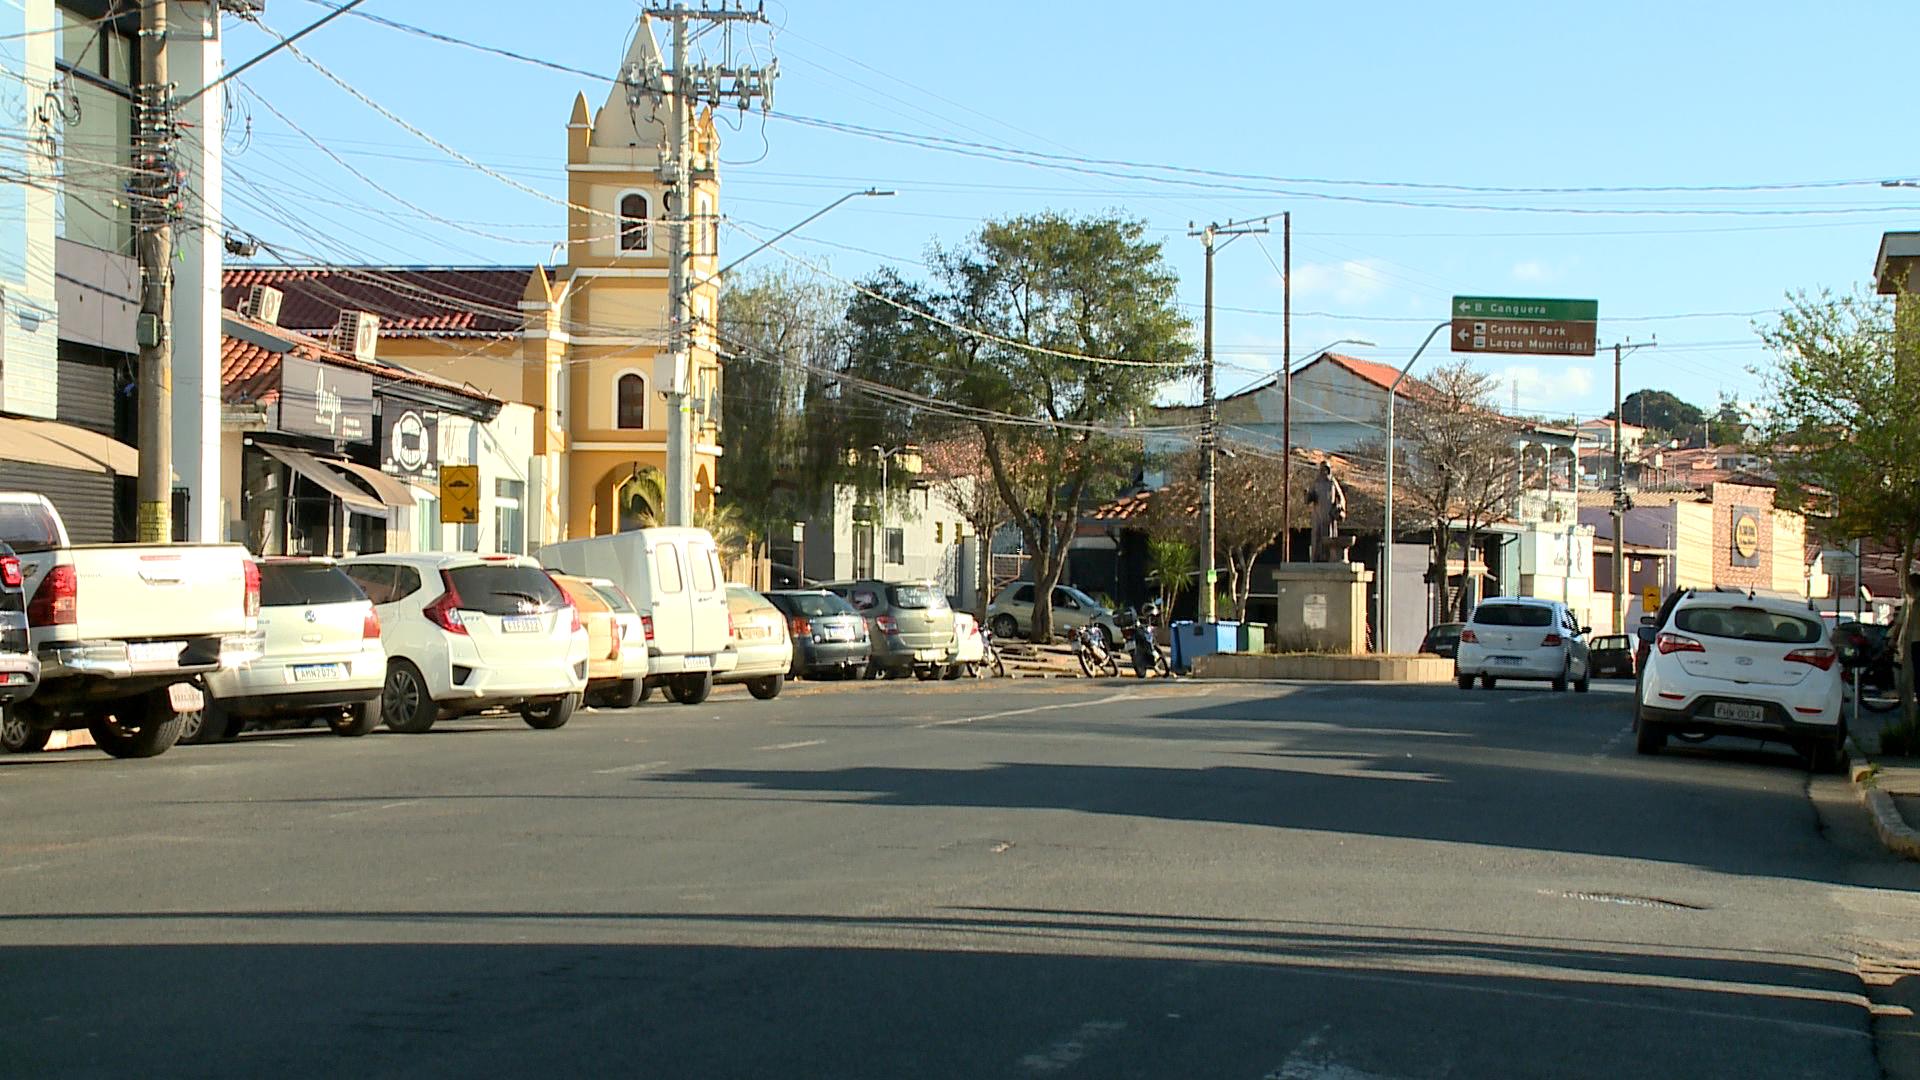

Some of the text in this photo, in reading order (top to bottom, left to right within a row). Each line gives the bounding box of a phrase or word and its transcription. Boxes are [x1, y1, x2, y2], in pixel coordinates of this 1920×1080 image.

[1490, 303, 1546, 315] Canguera
[1490, 324, 1566, 336] Central Park
[1489, 338, 1588, 351] Lagoa Municipal
